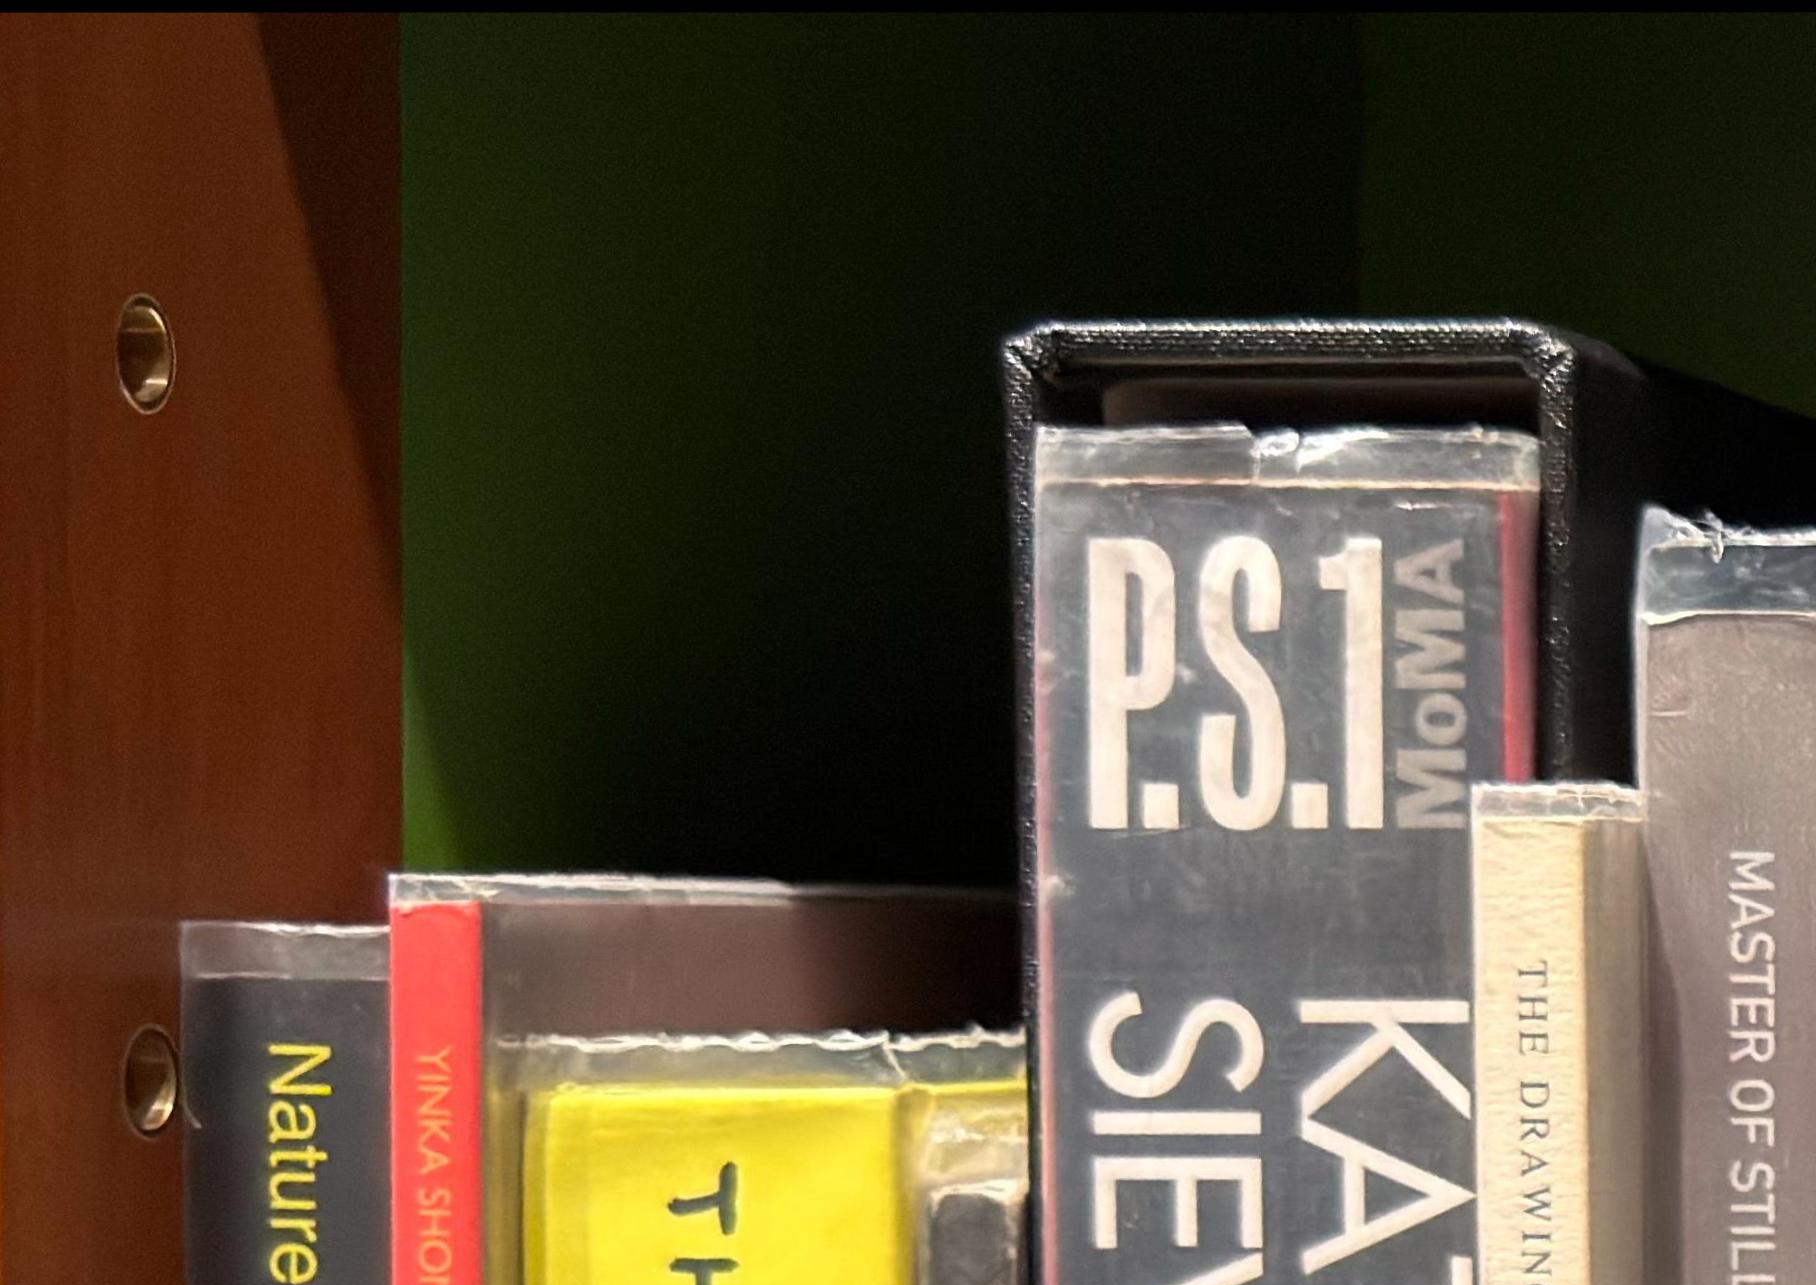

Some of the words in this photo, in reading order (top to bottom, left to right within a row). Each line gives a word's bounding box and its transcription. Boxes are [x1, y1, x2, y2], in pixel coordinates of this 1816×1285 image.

[1517, 962, 1550, 1055] THE
[1728, 850, 1775, 1062] MASTER
[268, 1040, 332, 1285] Nature
[416, 1047, 454, 1173] YINKA
[1730, 1080, 1776, 1145] OF
